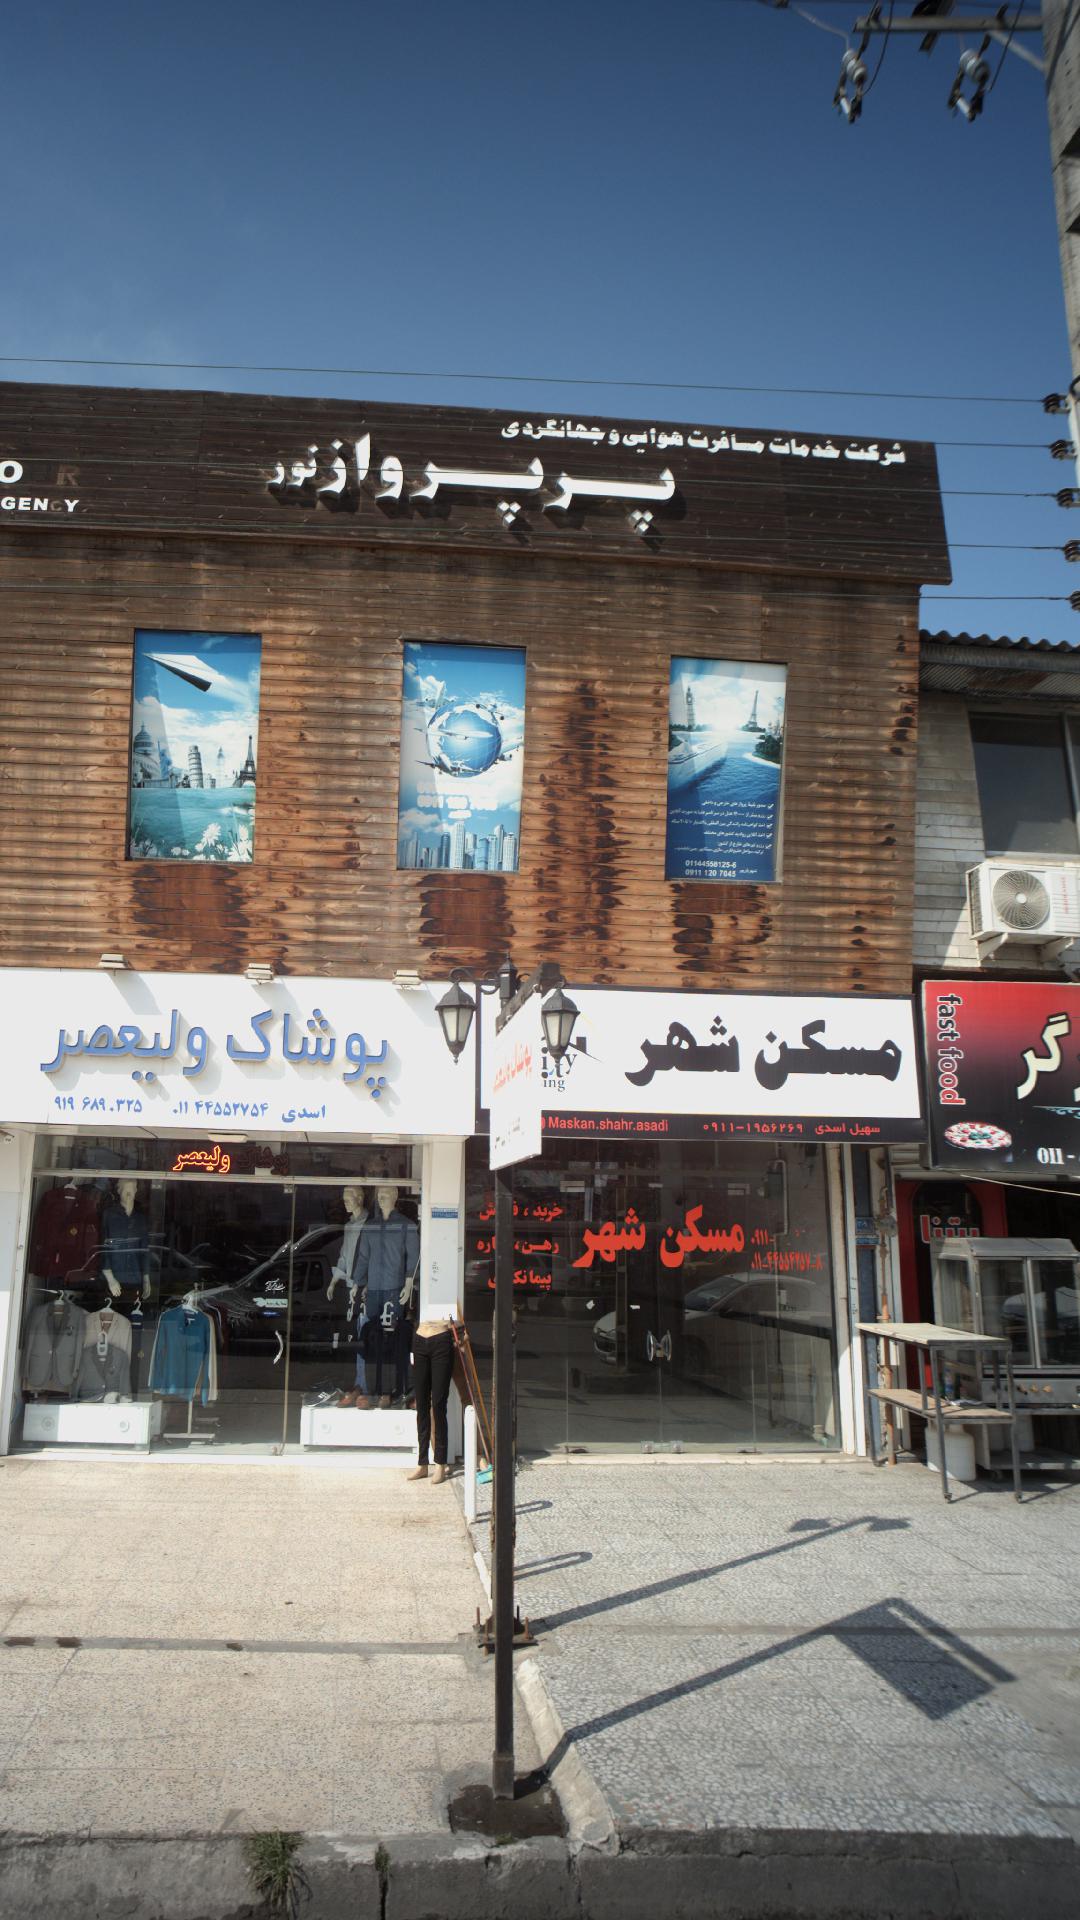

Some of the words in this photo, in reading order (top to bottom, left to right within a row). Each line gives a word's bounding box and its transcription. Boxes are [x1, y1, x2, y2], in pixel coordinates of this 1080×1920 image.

[501, 418, 606, 446] جهانگردی
[607, 429, 620, 446] و
[687, 430, 765, 454] مسافرت
[768, 438, 841, 458] خدمات
[845, 442, 906, 466] شرکت
[267, 445, 318, 487] نور
[0, 496, 80, 513] GENCY
[937, 993, 963, 1042] fast
[226, 1008, 389, 1099] پوشاک
[624, 1014, 741, 1087] شهر
[755, 1019, 903, 1091] مسکن
[1016, 1012, 1080, 1102] گر
[938, 1046, 967, 1106] food
[281, 1105, 326, 1123] اسدی
[548, 1116, 669, 1133] Maskan.shahr.asadi
[814, 1122, 846, 1135] اسدی
[849, 1123, 881, 1136] سهیل
[1036, 1147, 1065, 1165] 011
[572, 1206, 647, 1267] شهر
[660, 1205, 745, 1267] مسکن
